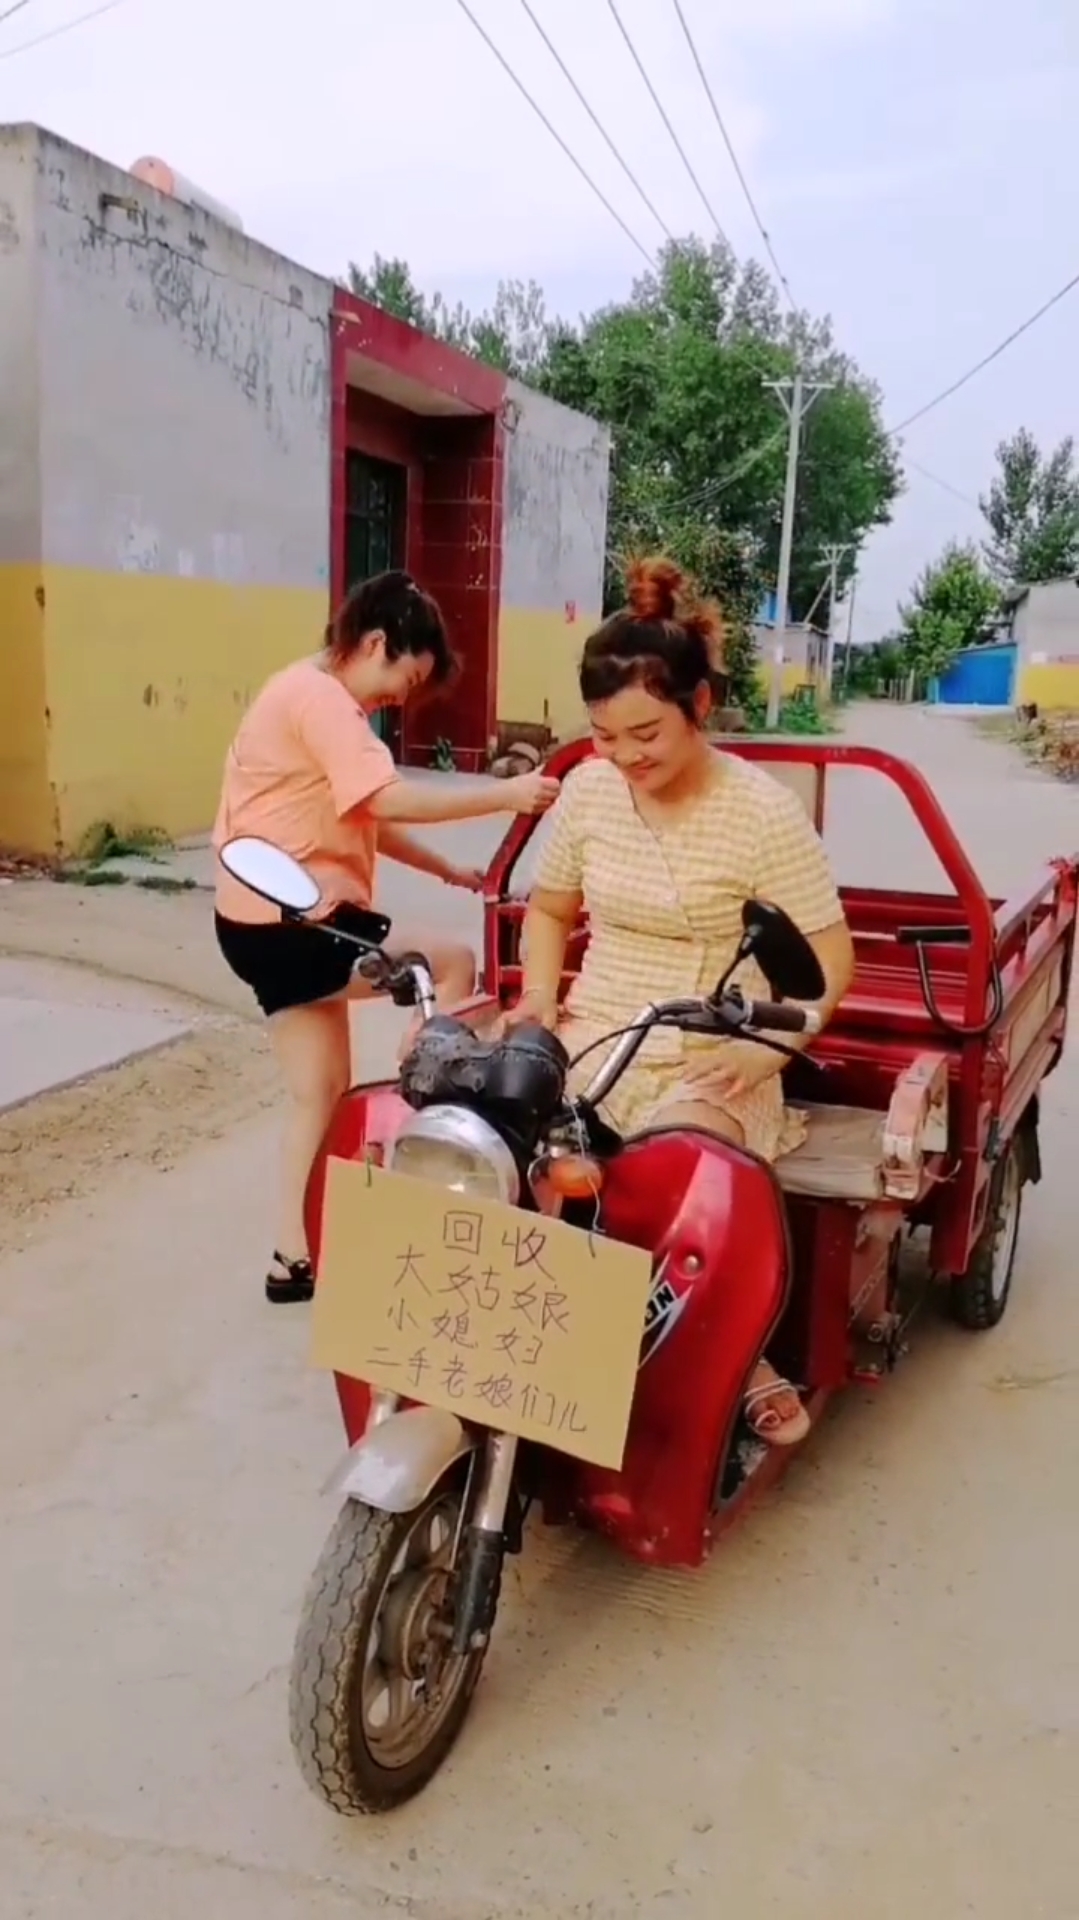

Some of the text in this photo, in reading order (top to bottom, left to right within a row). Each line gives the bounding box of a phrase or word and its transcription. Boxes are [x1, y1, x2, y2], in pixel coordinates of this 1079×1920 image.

[442, 1210, 556, 1281] 回收
[393, 1244, 570, 1334] 大姑娘
[387, 1297, 544, 1366] 小媳妇
[366, 1346, 588, 1432] 二手老娘们儿
